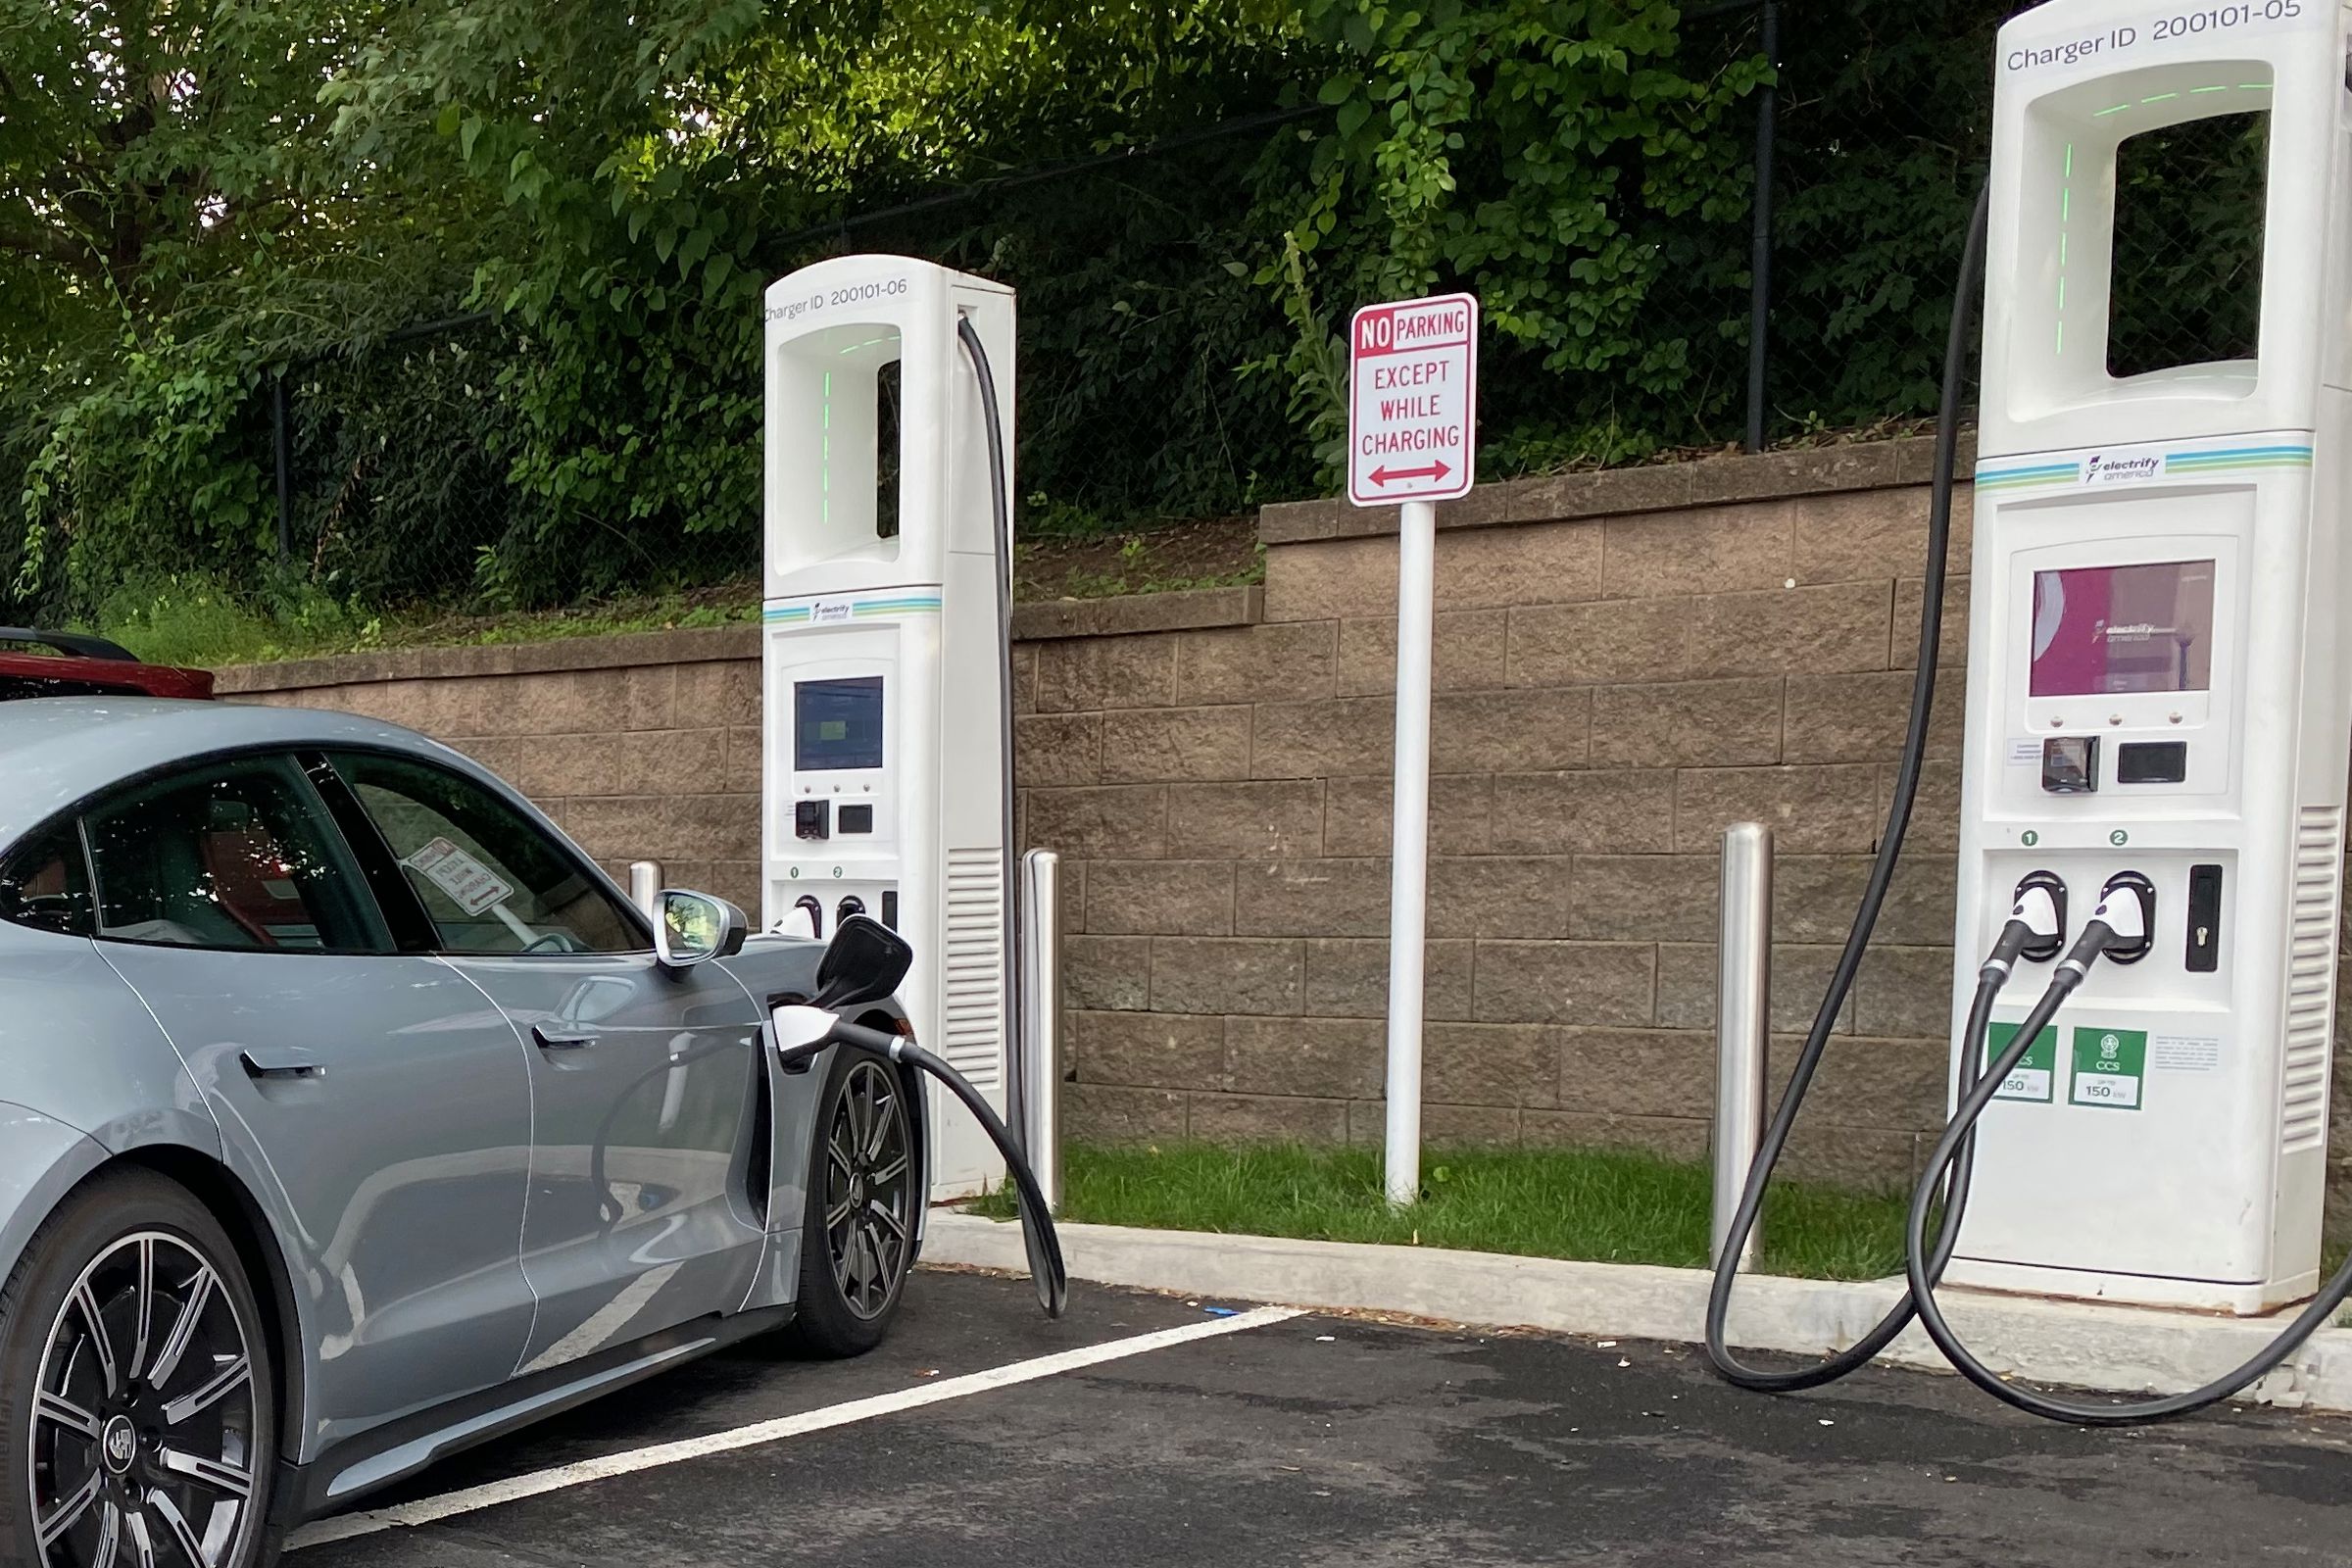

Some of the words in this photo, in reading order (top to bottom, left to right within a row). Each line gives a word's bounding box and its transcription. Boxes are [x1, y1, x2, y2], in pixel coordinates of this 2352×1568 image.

[2007, 36, 2104, 72] Charger
[2111, 26, 2136, 49] ID
[2152, 0, 2301, 41] 200101-05
[809, 295, 824, 311] ID
[830, 278, 907, 306] 200101-06
[1360, 317, 1392, 350] NO
[1396, 310, 1465, 341] PARKING
[1374, 360, 1450, 390] EXCEPT
[1380, 394, 1442, 421] WHILE
[1361, 425, 1460, 457] CHARGING
[2103, 457, 2160, 470] electrify
[2095, 1060, 2121, 1072] CCS
[2085, 1086, 2111, 1097] 150
